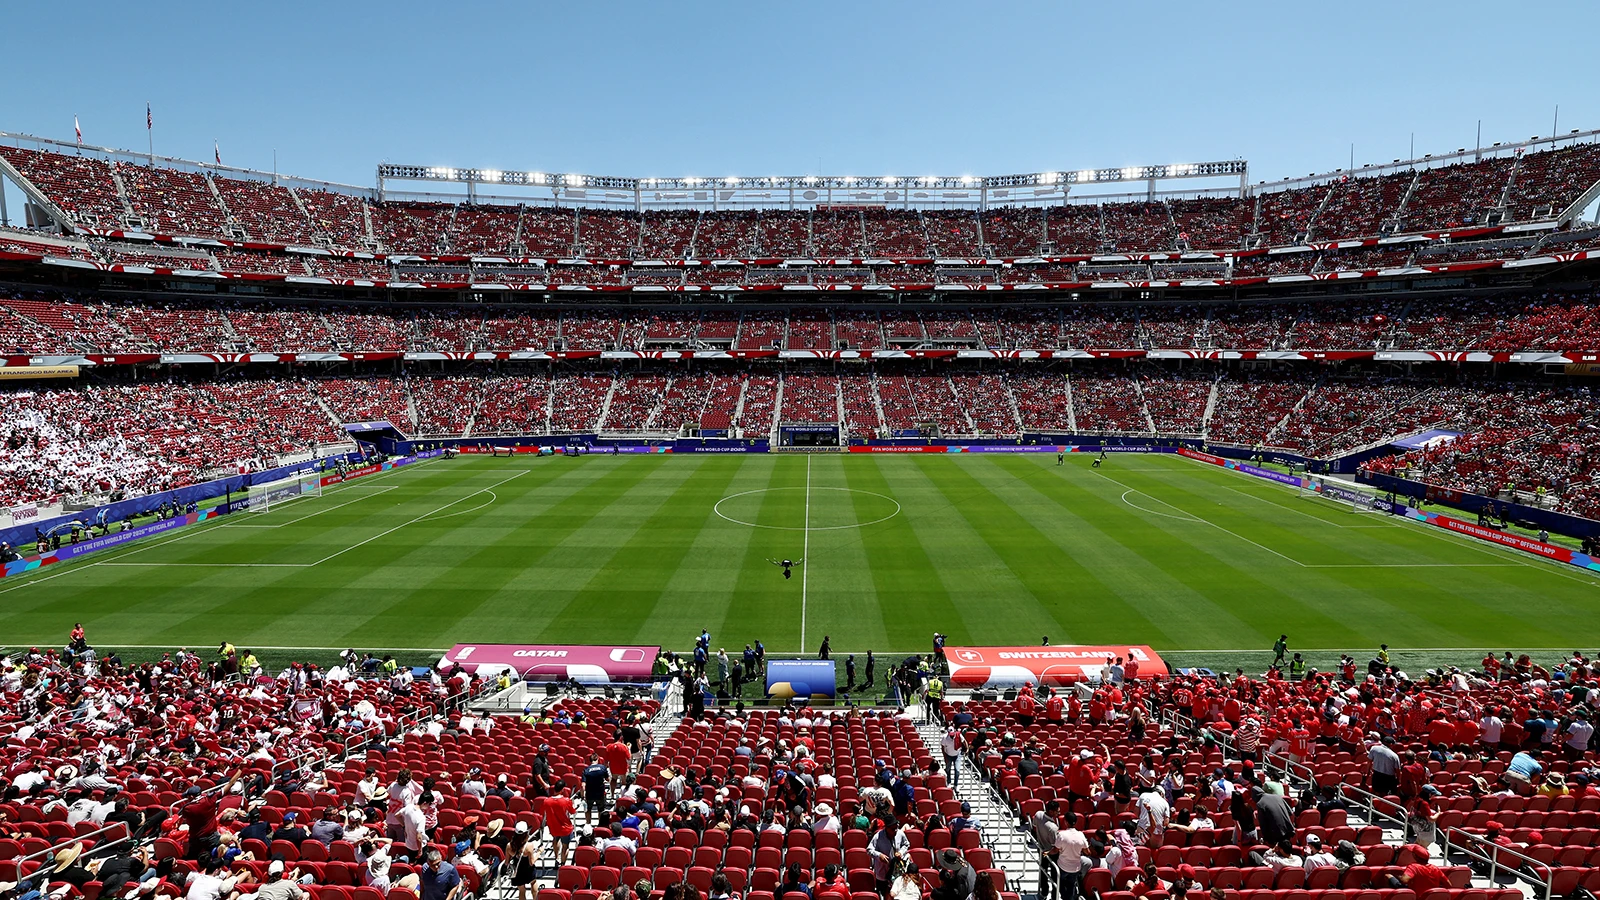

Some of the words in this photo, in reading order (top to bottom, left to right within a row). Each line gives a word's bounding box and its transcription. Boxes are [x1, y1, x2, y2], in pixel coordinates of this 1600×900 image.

[72, 545, 83, 554] GET
[83, 543, 93, 551] THE
[93, 540, 104, 549] FIFA
[104, 534, 122, 545] WORLD
[122, 532, 132, 540] CUP
[148, 523, 167, 533] OFFICIAL
[1449, 520, 1457, 528] GET
[1457, 522, 1465, 530] THE
[1465, 525, 1475, 533] FIFA
[1475, 528, 1492, 538] WORLD
[1492, 532, 1502, 540] CUP
[1520, 540, 1543, 552] OFFICIAL
[1543, 547, 1556, 555] APP
[512, 649, 569, 658] QATAR
[998, 651, 1117, 659] SWITZERLAND
[1178, 694, 1188, 704] 20
[1019, 700, 1028, 710] 10
[1053, 703, 1061, 712] 10
[223, 709, 234, 719] 10
[1347, 730, 1354, 740] 7
[1299, 739, 1306, 750] 11
